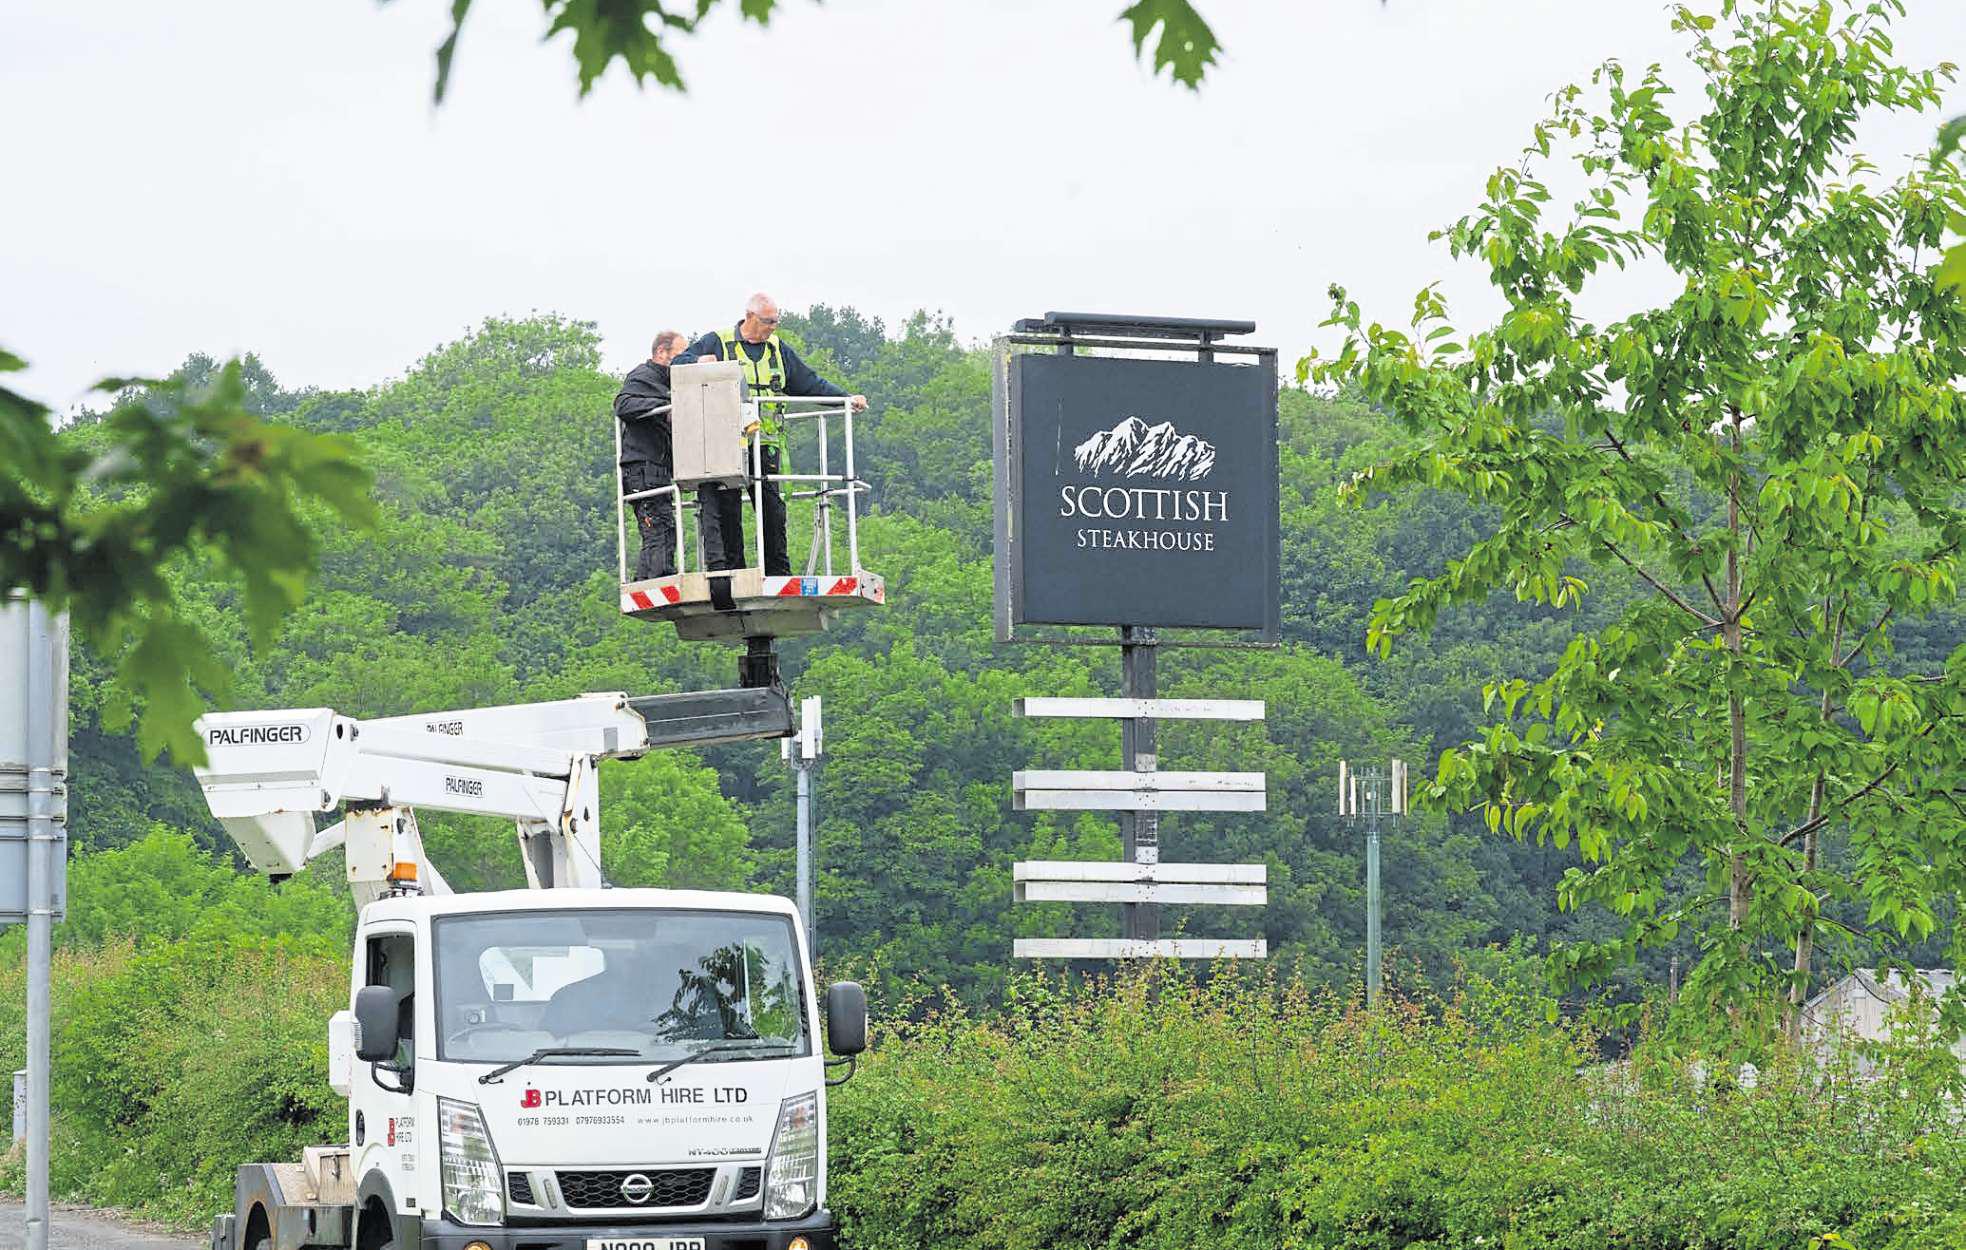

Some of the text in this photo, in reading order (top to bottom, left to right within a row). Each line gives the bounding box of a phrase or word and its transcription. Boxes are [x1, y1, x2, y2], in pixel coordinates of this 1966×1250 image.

[1060, 485, 1229, 522] SCOTTISH
[1076, 528, 1215, 551] STEAKHOUSE
[209, 725, 302, 745] PALFINGER
[445, 776, 483, 796] PALFINGER
[545, 1088, 652, 1106] PLATFORM
[661, 1087, 705, 1104] HIRE
[713, 1087, 748, 1104] LTD
[543, 1116, 570, 1126] 759331
